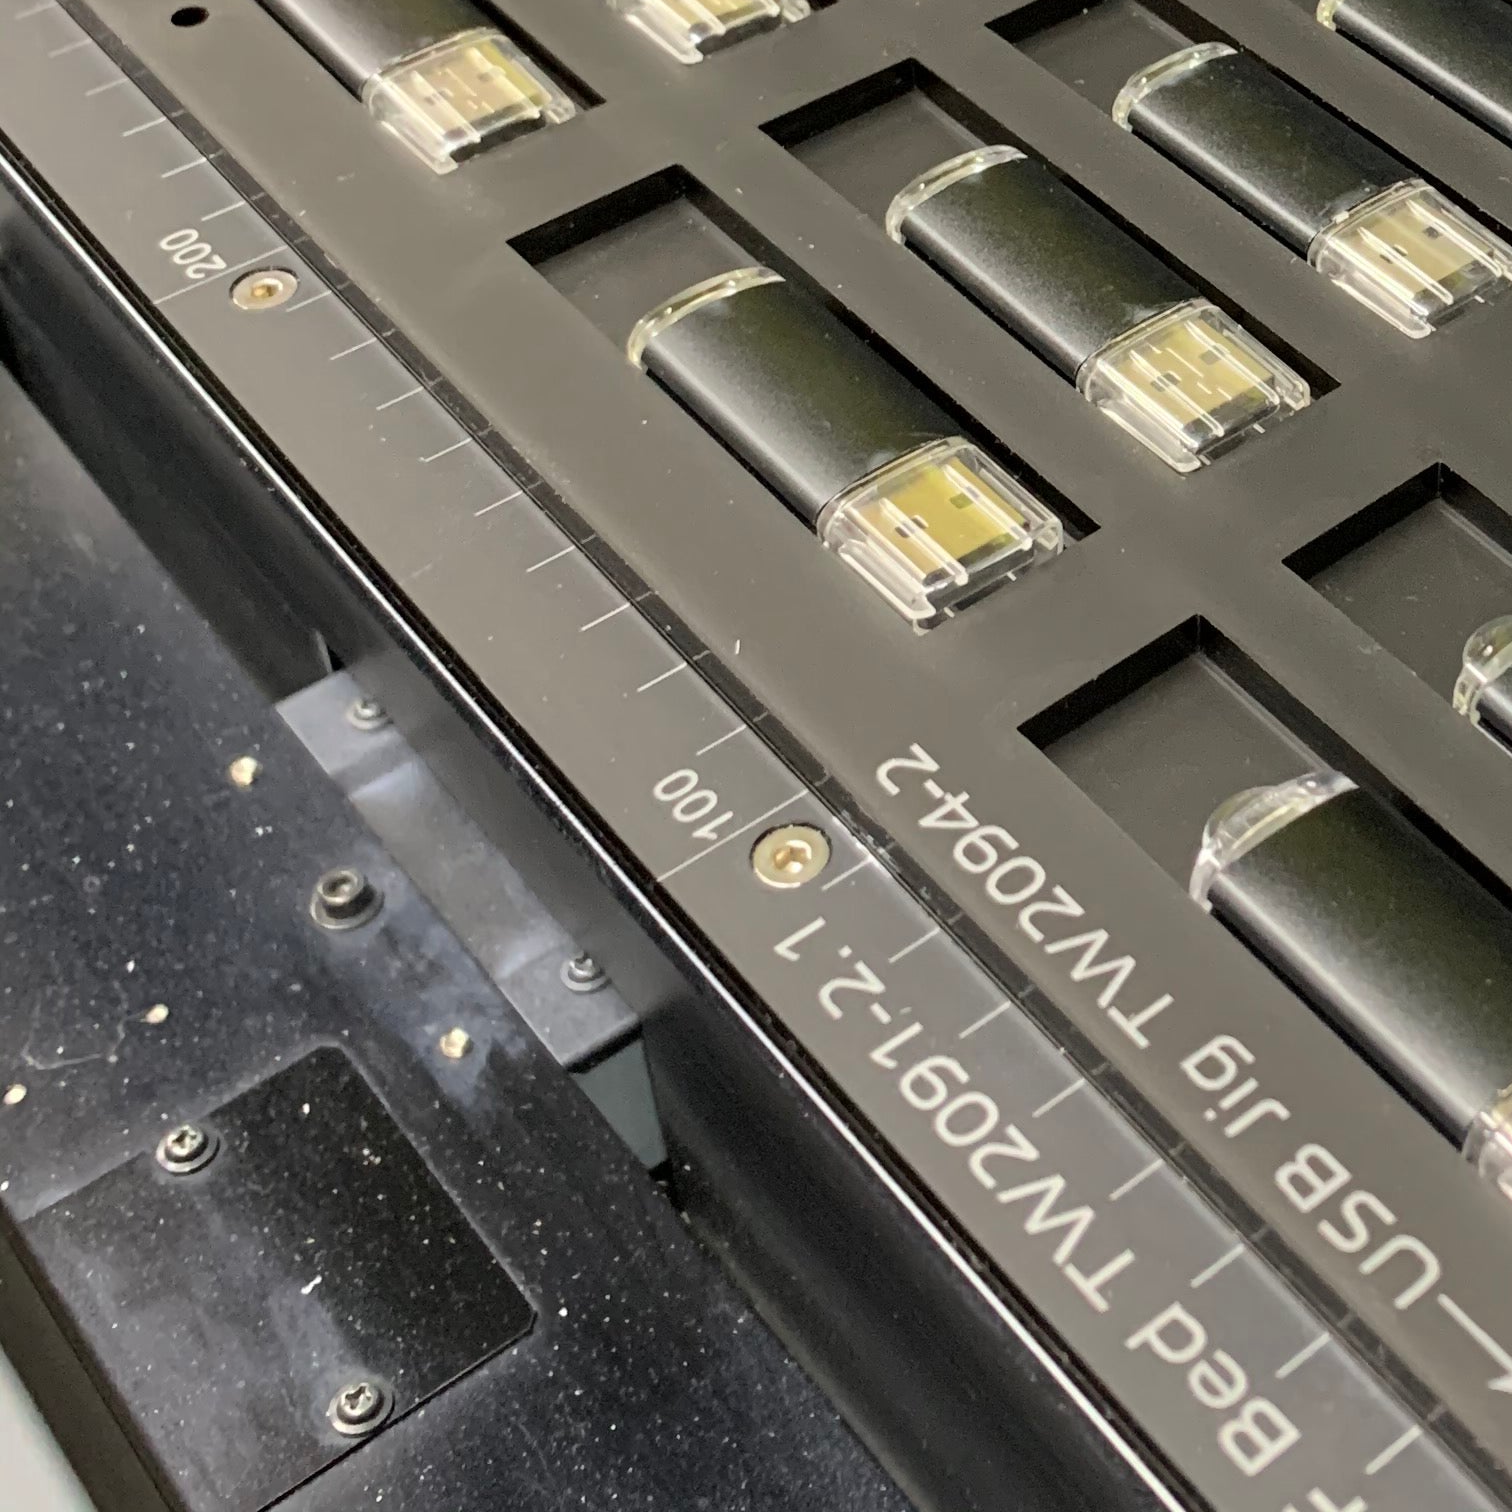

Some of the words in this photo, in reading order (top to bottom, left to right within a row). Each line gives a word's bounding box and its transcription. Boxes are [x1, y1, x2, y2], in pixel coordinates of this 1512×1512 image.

[158, 227, 227, 279] 200
[653, 766, 732, 841] 100
[876, 741, 1175, 1049] TW2094-2
[1181, 1033, 1291, 1137] Jig
[1275, 1143, 1441, 1311] USB
[1125, 1302, 1303, 1477] Bed
